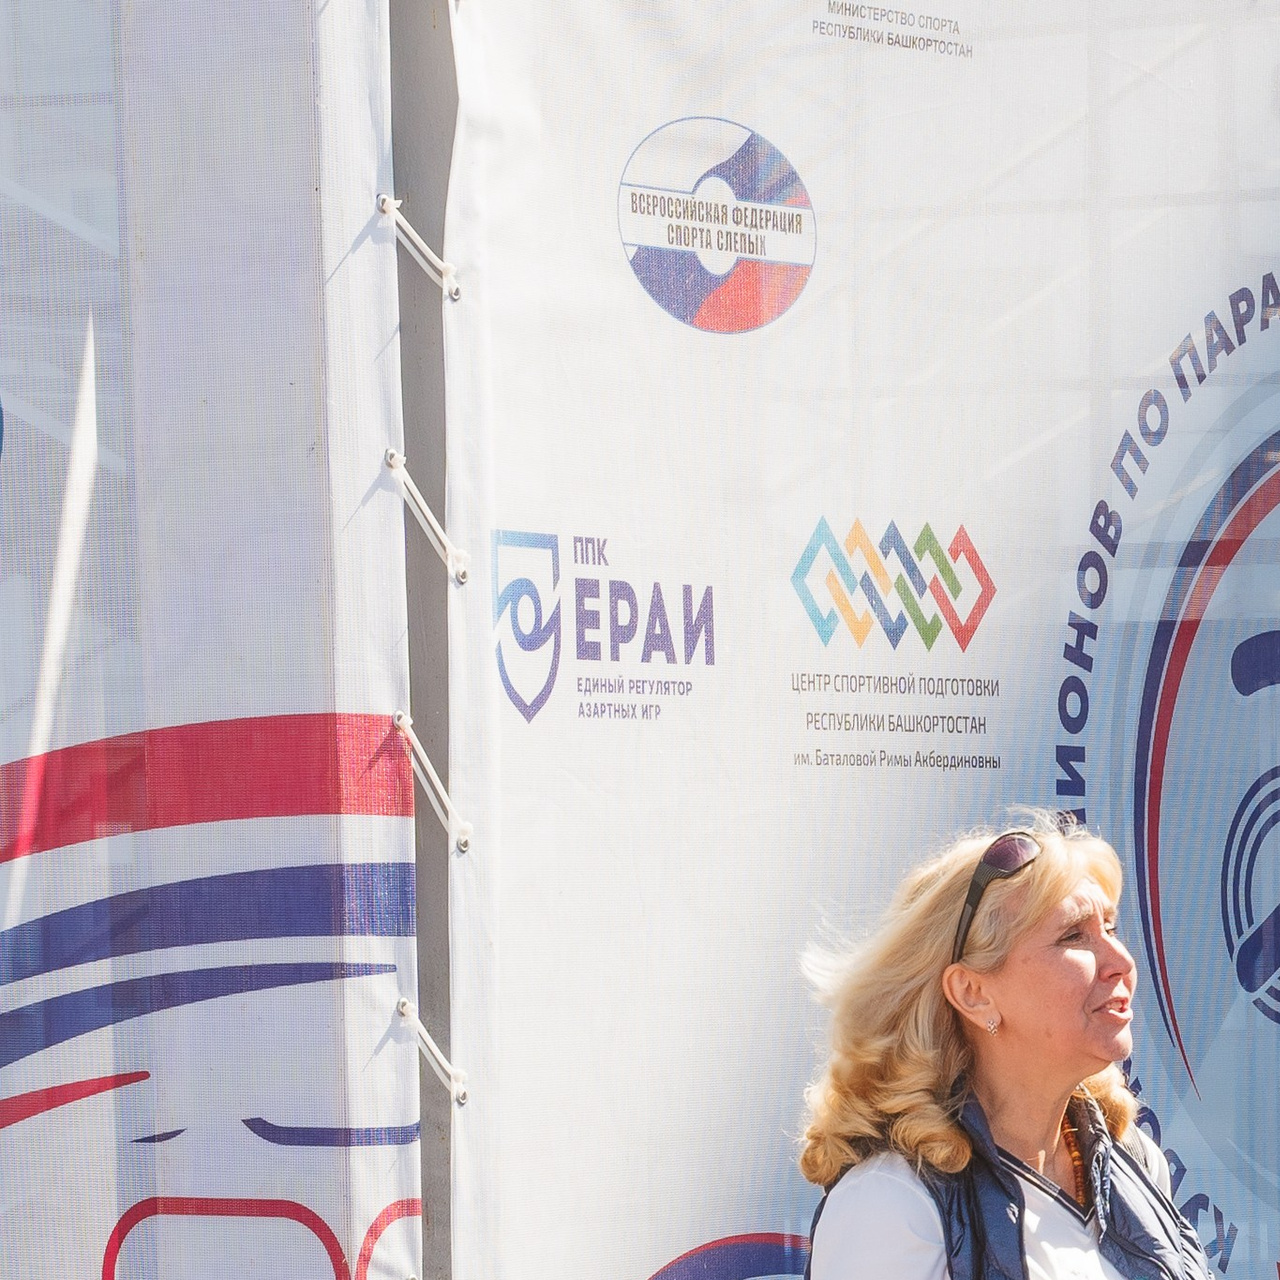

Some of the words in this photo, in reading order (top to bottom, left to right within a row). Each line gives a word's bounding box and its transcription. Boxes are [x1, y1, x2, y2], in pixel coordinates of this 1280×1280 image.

[828, 0, 915, 26] МИНИСТЕРСТВО
[919, 15, 960, 35] СПОРТА
[812, 20, 884, 44] РЕСПУБЛИКИ
[887, 32, 973, 58] БАШКОРТОСТАН
[631, 192, 728, 225] ВСЕРОССИЙСКАЯ
[732, 206, 802, 235] ФЕДЕРАЦИЯ
[667, 223, 712, 249] СПОРТА
[716, 229, 766, 256] СЛЕПЫХ
[573, 536, 609, 566] ППК
[1056, 500, 1122, 824] ИОНОВ
[1109, 388, 1170, 500] ПО
[575, 578, 715, 666] ЕРАИ
[577, 675, 624, 696] ЕДИНЫЙ
[628, 679, 693, 696] РЕГУЛЯТОР
[791, 673, 831, 694] ЦЕНТР
[834, 671, 915, 695] СПОРТИВНОЙ
[919, 677, 1000, 698] ПОДГОТОВКИ
[578, 702, 637, 719] АЗАРТНЫХ
[641, 704, 661, 720] ИГР
[806, 712, 885, 732] РЕСПУБЛИКИ
[888, 714, 986, 734] БАШКОРТОСТАН
[794, 753, 813, 766] им.
[815, 749, 876, 767] Баталовой
[879, 750, 911, 767] Римы
[914, 750, 1000, 772] Акбердиновны
